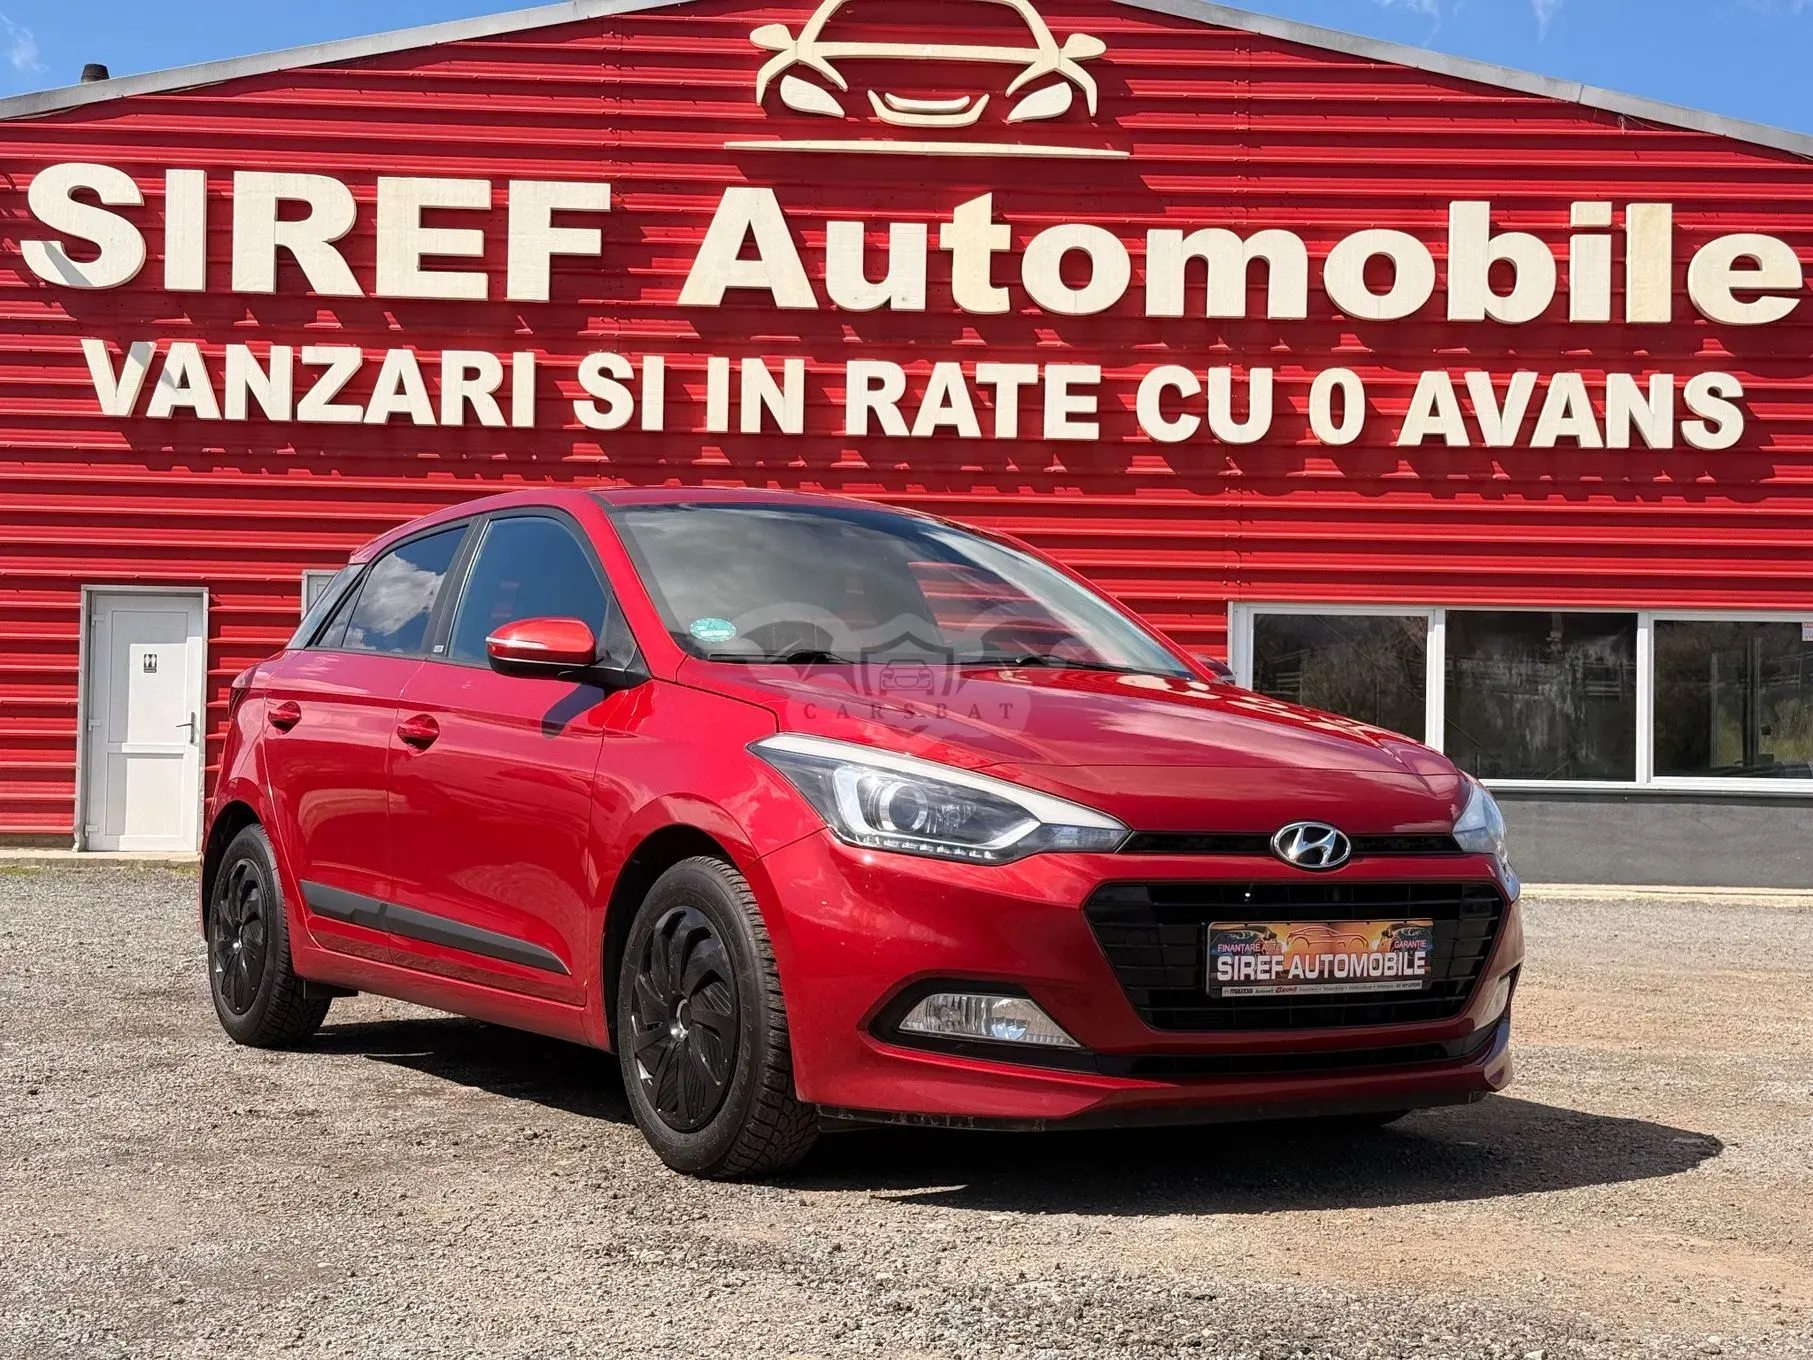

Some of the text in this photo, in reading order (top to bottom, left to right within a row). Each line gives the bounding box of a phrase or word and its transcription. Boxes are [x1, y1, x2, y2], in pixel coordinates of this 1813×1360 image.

[20, 162, 1804, 326] SIREF Automobile
[81, 339, 536, 428] VANZARI
[573, 352, 666, 432] SI
[706, 357, 806, 436] IN
[845, 360, 1101, 442] RATE
[1136, 365, 1274, 445] CU
[1397, 370, 1745, 451] AVANS
[1216, 951, 1426, 982] SIREF AUTOMOBILE
[1261, 943, 1282, 953] AUTO
